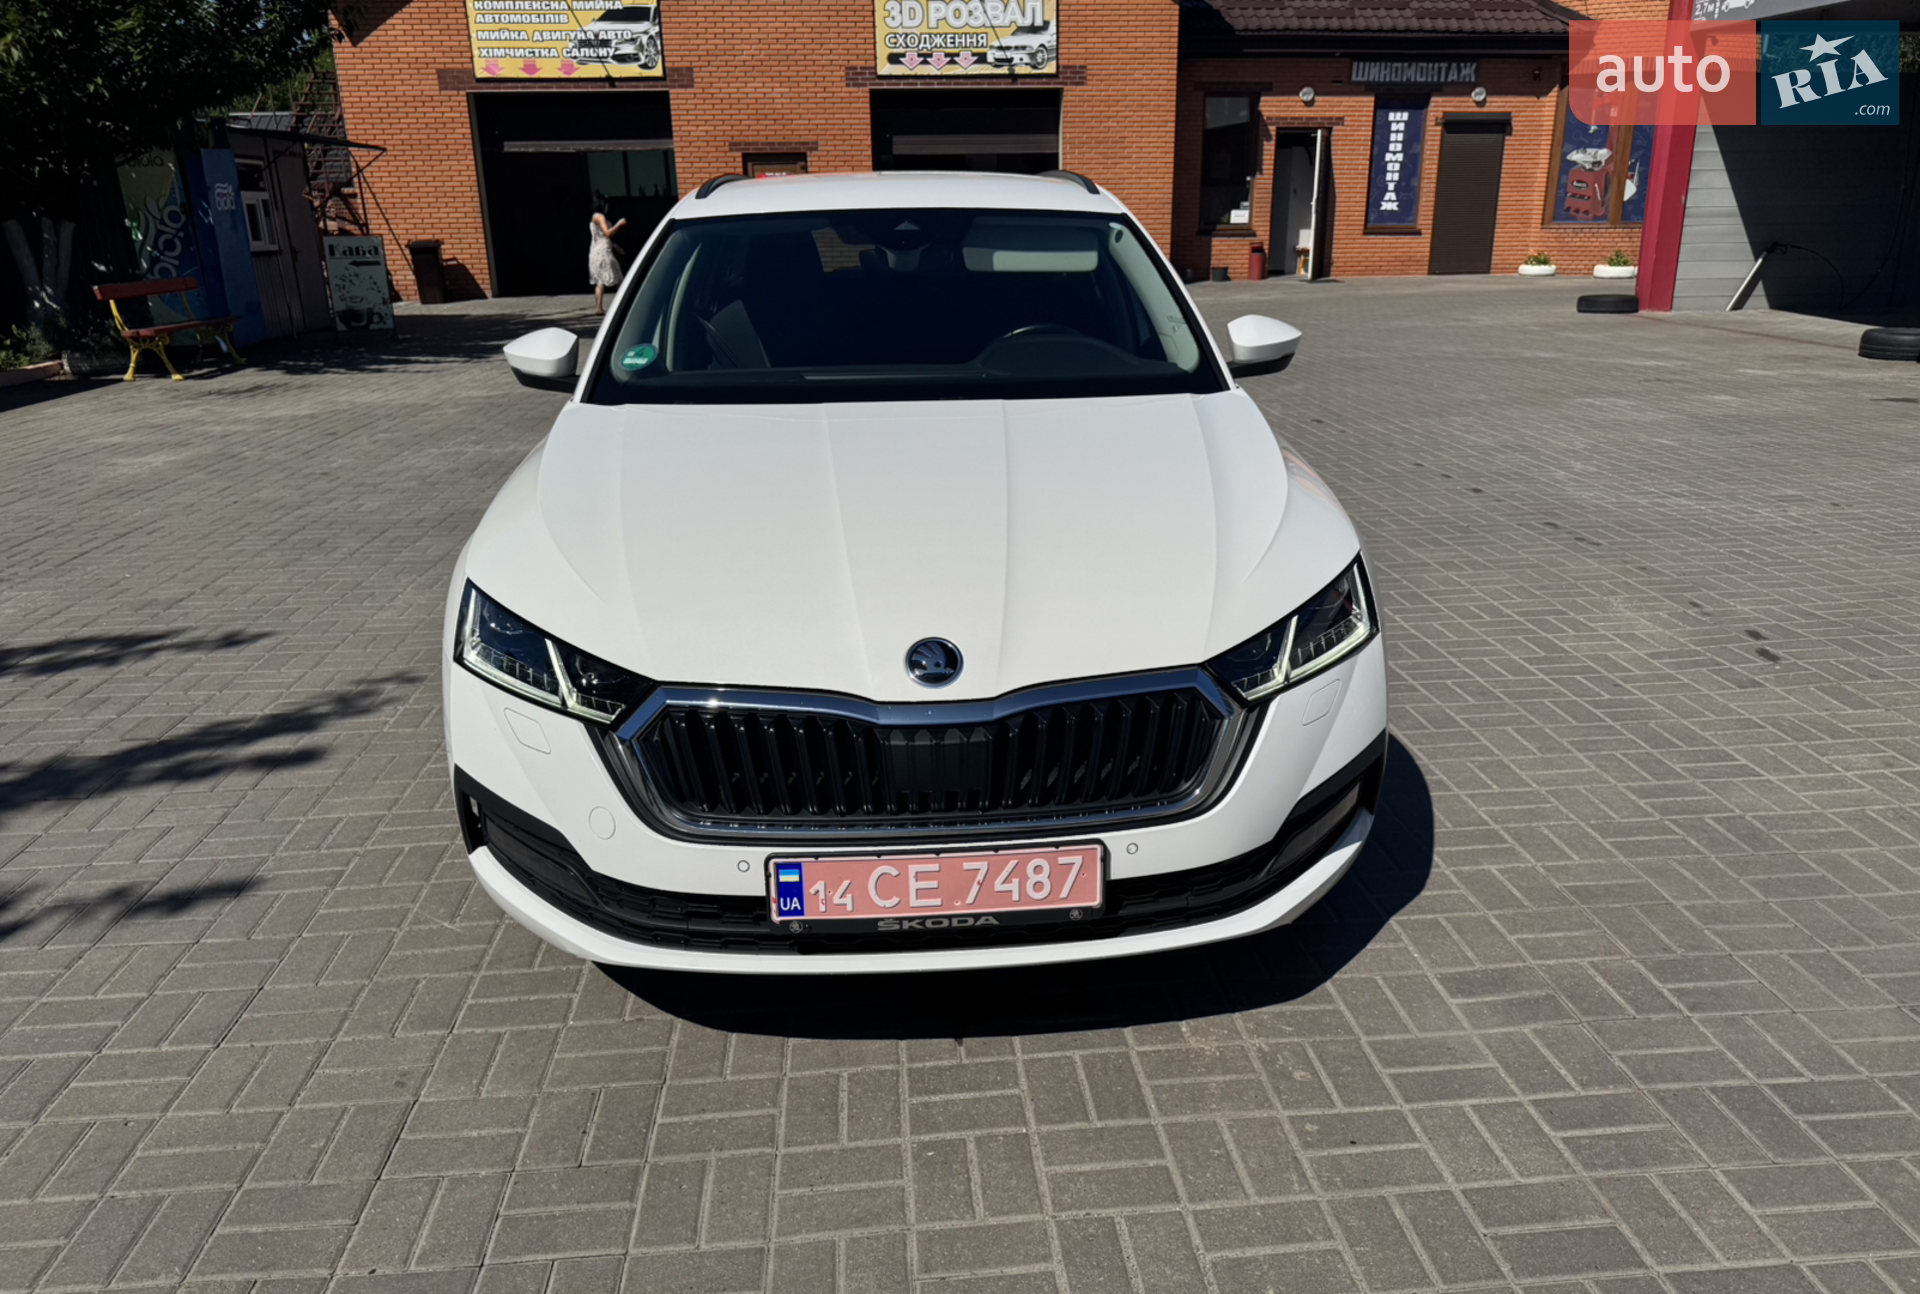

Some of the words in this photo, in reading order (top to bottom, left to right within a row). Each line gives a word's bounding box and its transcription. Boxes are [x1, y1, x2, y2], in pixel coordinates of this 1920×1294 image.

[474, 0, 569, 11] КОМПЛЕКСНА
[572, 0, 623, 10] МИЙКА
[475, 13, 569, 24] АВТОМОБІЛІВ
[884, 0, 924, 29] 3D
[927, 0, 1044, 29] РОЗВАЛ
[477, 29, 528, 41] МИЙКА
[532, 30, 594, 42] ДВИГУНА
[599, 30, 632, 40] АВТО
[885, 33, 988, 50] СХОДЖЕННЯ
[479, 48, 559, 58] ХІМЧИСТКА
[563, 48, 615, 58] САЛОНУ
[1351, 61, 1478, 82] ШИНОМОНТАЖ
[1379, 112, 1409, 211] ШИНОМОНТАЖ
[328, 244, 380, 257] Кава
[809, 880, 854, 913] 14
[868, 863, 943, 908] CE
[962, 855, 1084, 905] 7487
[780, 897, 801, 912] UA
